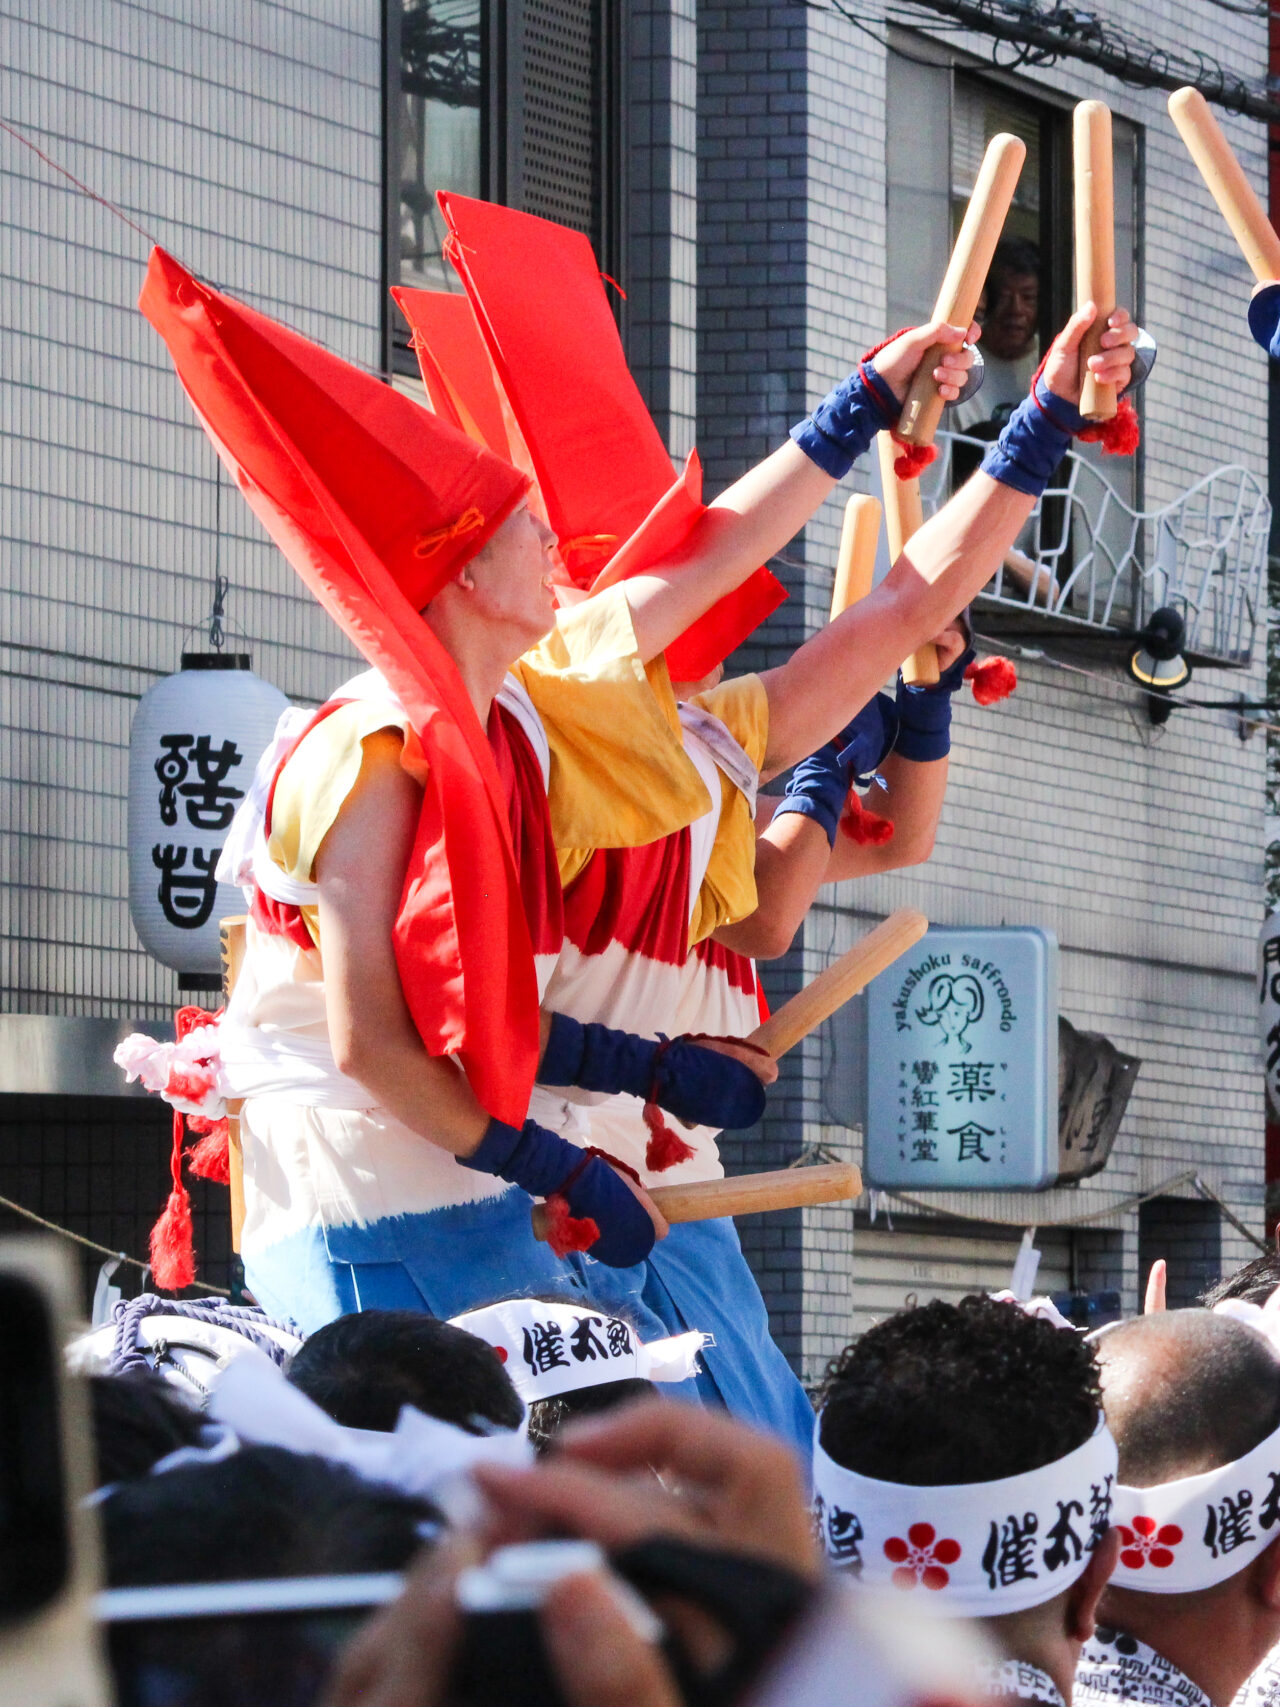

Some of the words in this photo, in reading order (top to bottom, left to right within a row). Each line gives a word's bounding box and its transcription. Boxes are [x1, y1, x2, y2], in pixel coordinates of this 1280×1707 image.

[892, 954, 951, 1032] yakushoku
[961, 954, 1017, 1032] saffrondo
[946, 1061, 996, 1162] 薬食
